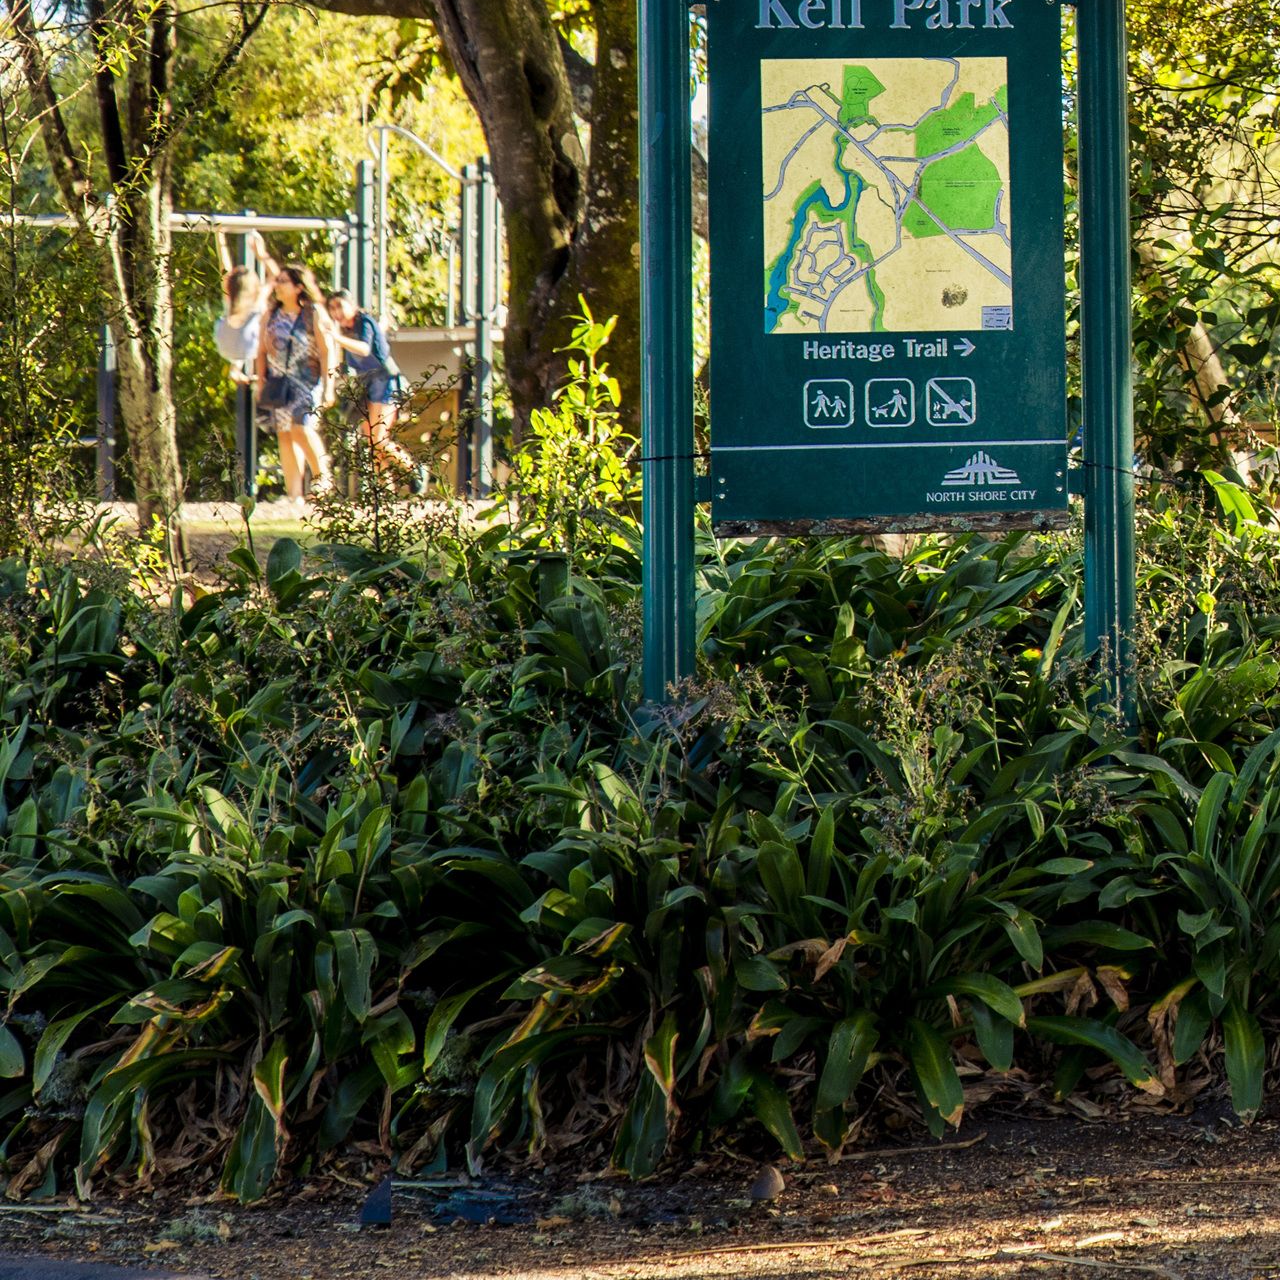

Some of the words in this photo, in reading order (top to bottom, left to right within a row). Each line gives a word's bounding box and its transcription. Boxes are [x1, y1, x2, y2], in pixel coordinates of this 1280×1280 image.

[803, 340, 895, 362] Heritage
[902, 338, 948, 358] Trail
[926, 491, 965, 502] NORTH
[968, 490, 1007, 502] SHORE
[1010, 489, 1037, 501] CITY
